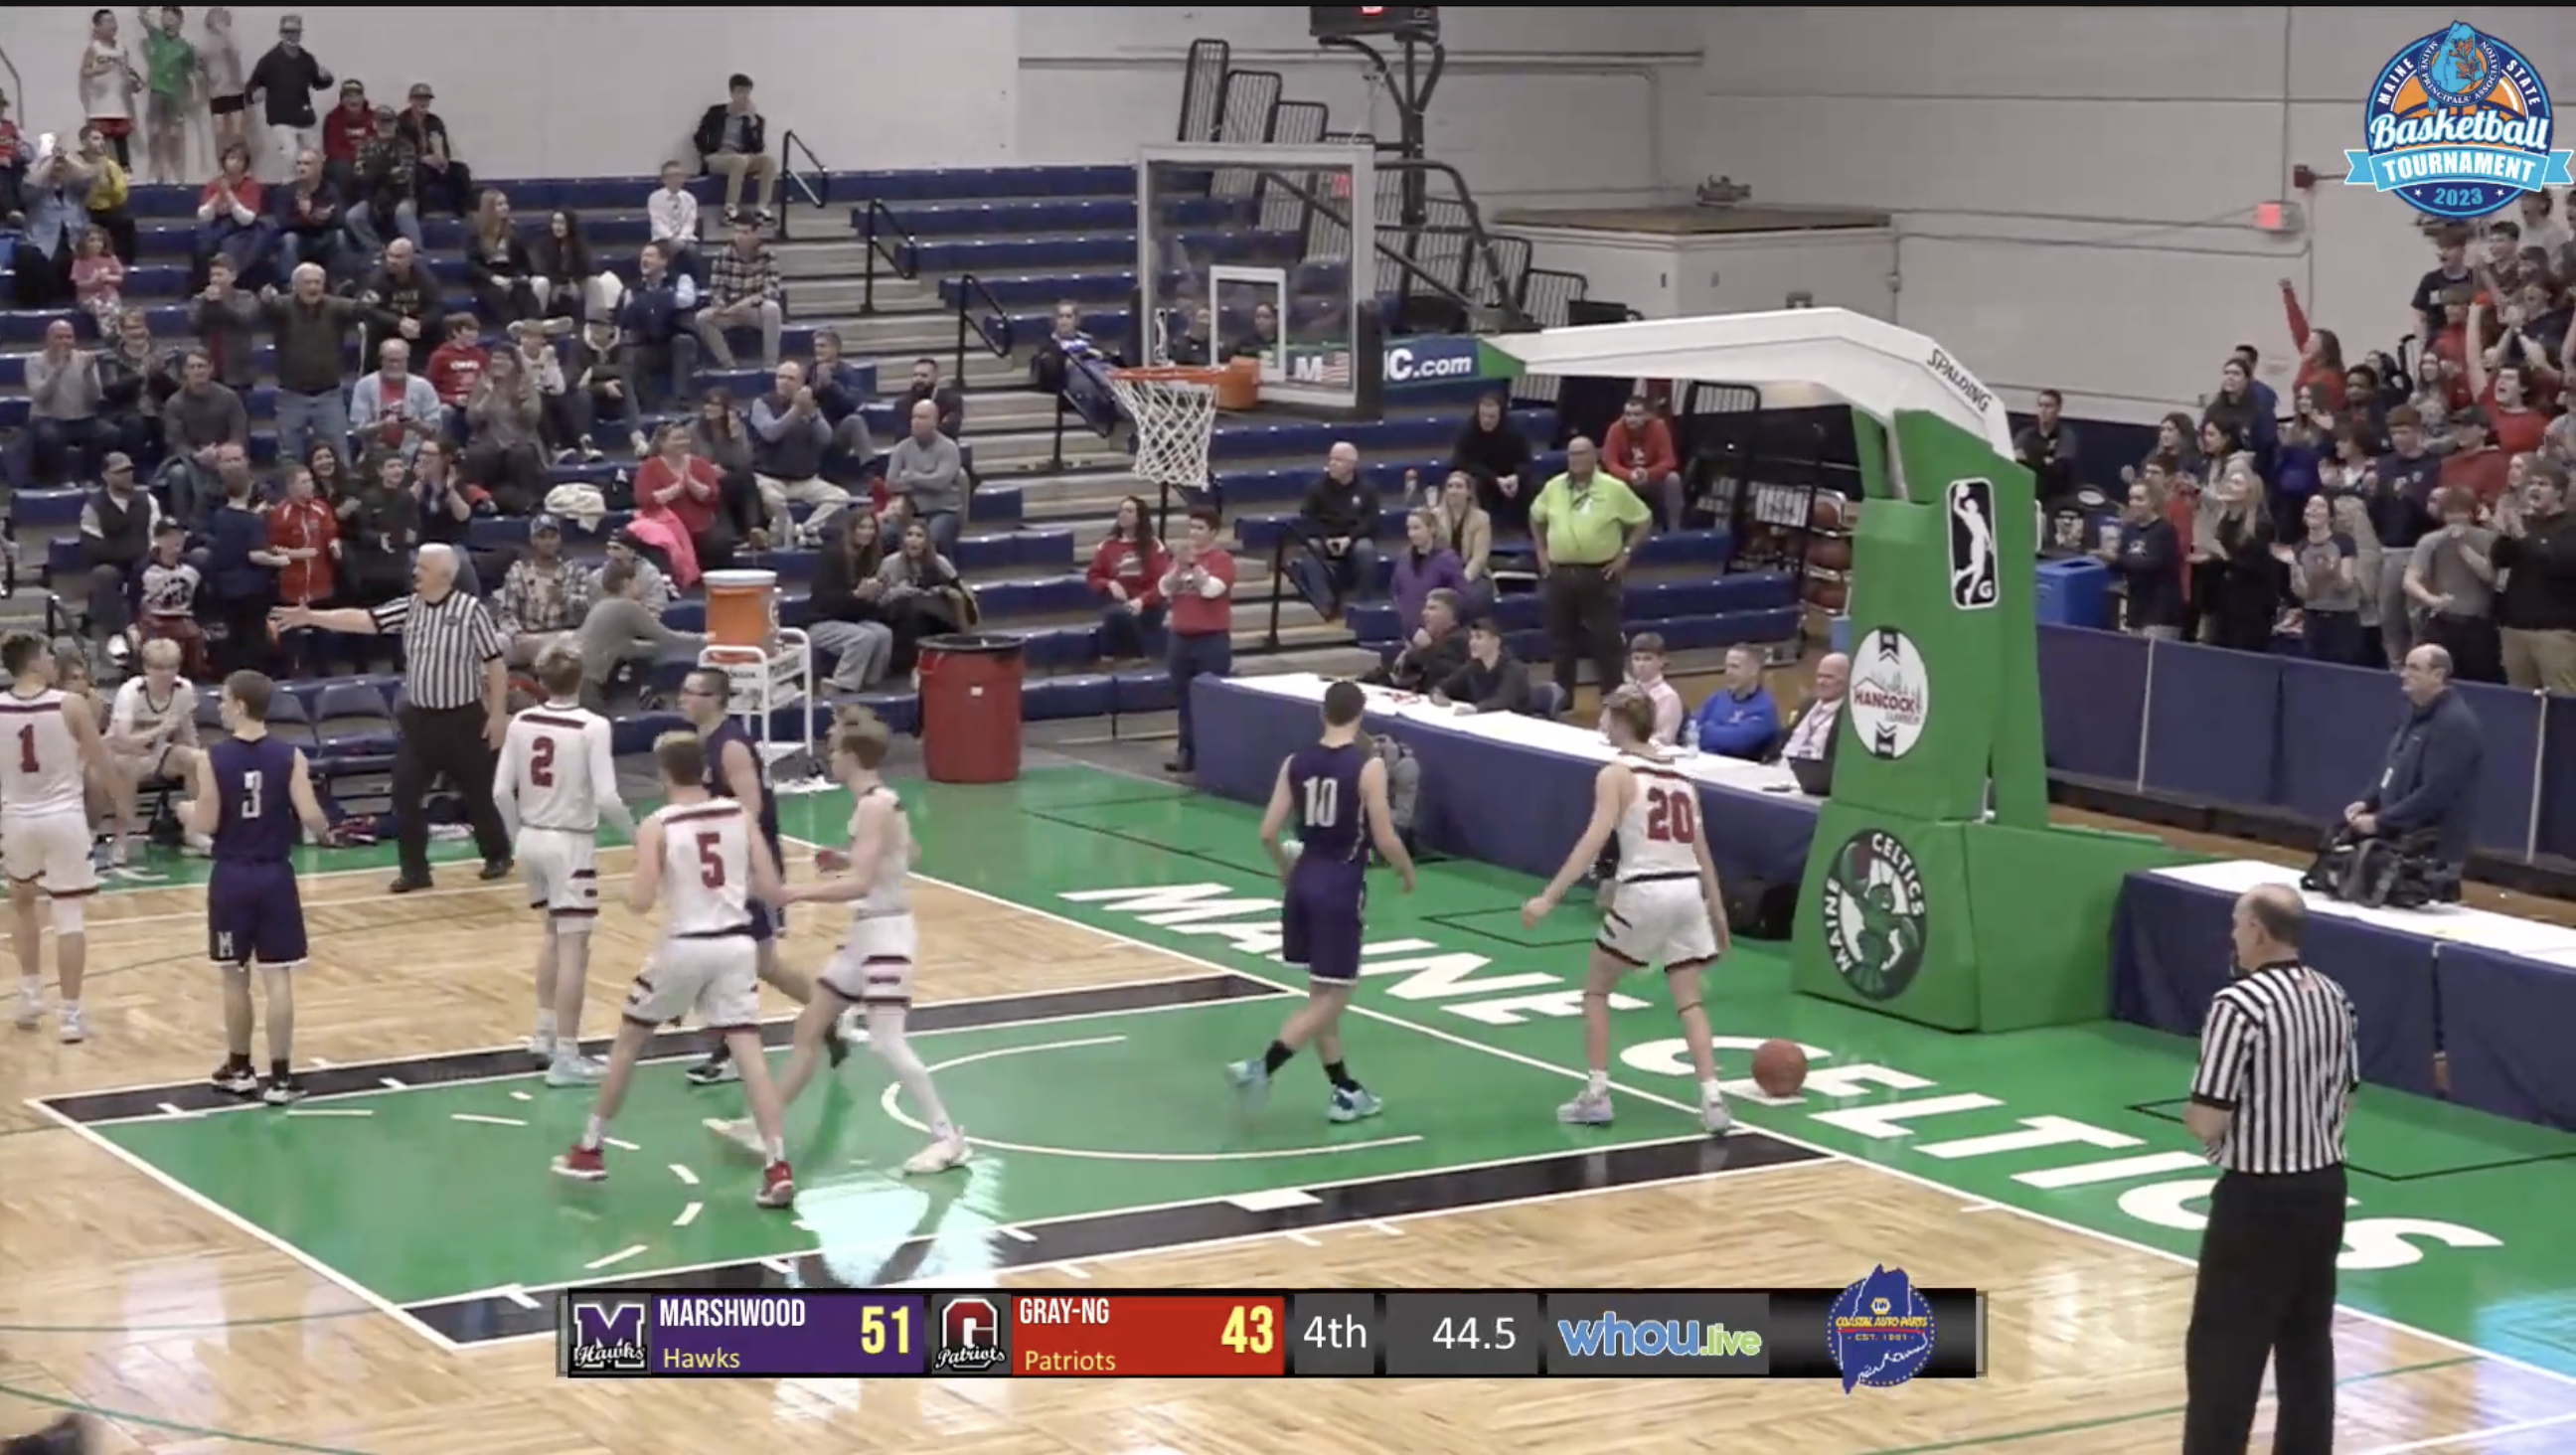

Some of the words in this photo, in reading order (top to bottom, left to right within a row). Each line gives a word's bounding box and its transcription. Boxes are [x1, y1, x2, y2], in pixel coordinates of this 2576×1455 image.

[1926, 348, 1993, 412] SPALDING
[1852, 689, 1917, 714] HANCOCK
[18, 724, 40, 773] 1
[530, 736, 555, 787] 2
[242, 770, 262, 818] 3
[1303, 776, 1339, 827] 10
[1647, 786, 1696, 844] 20
[698, 832, 724, 889] 5
[1825, 878, 1852, 972] MAINE
[1871, 833, 1925, 916] CELTICS
